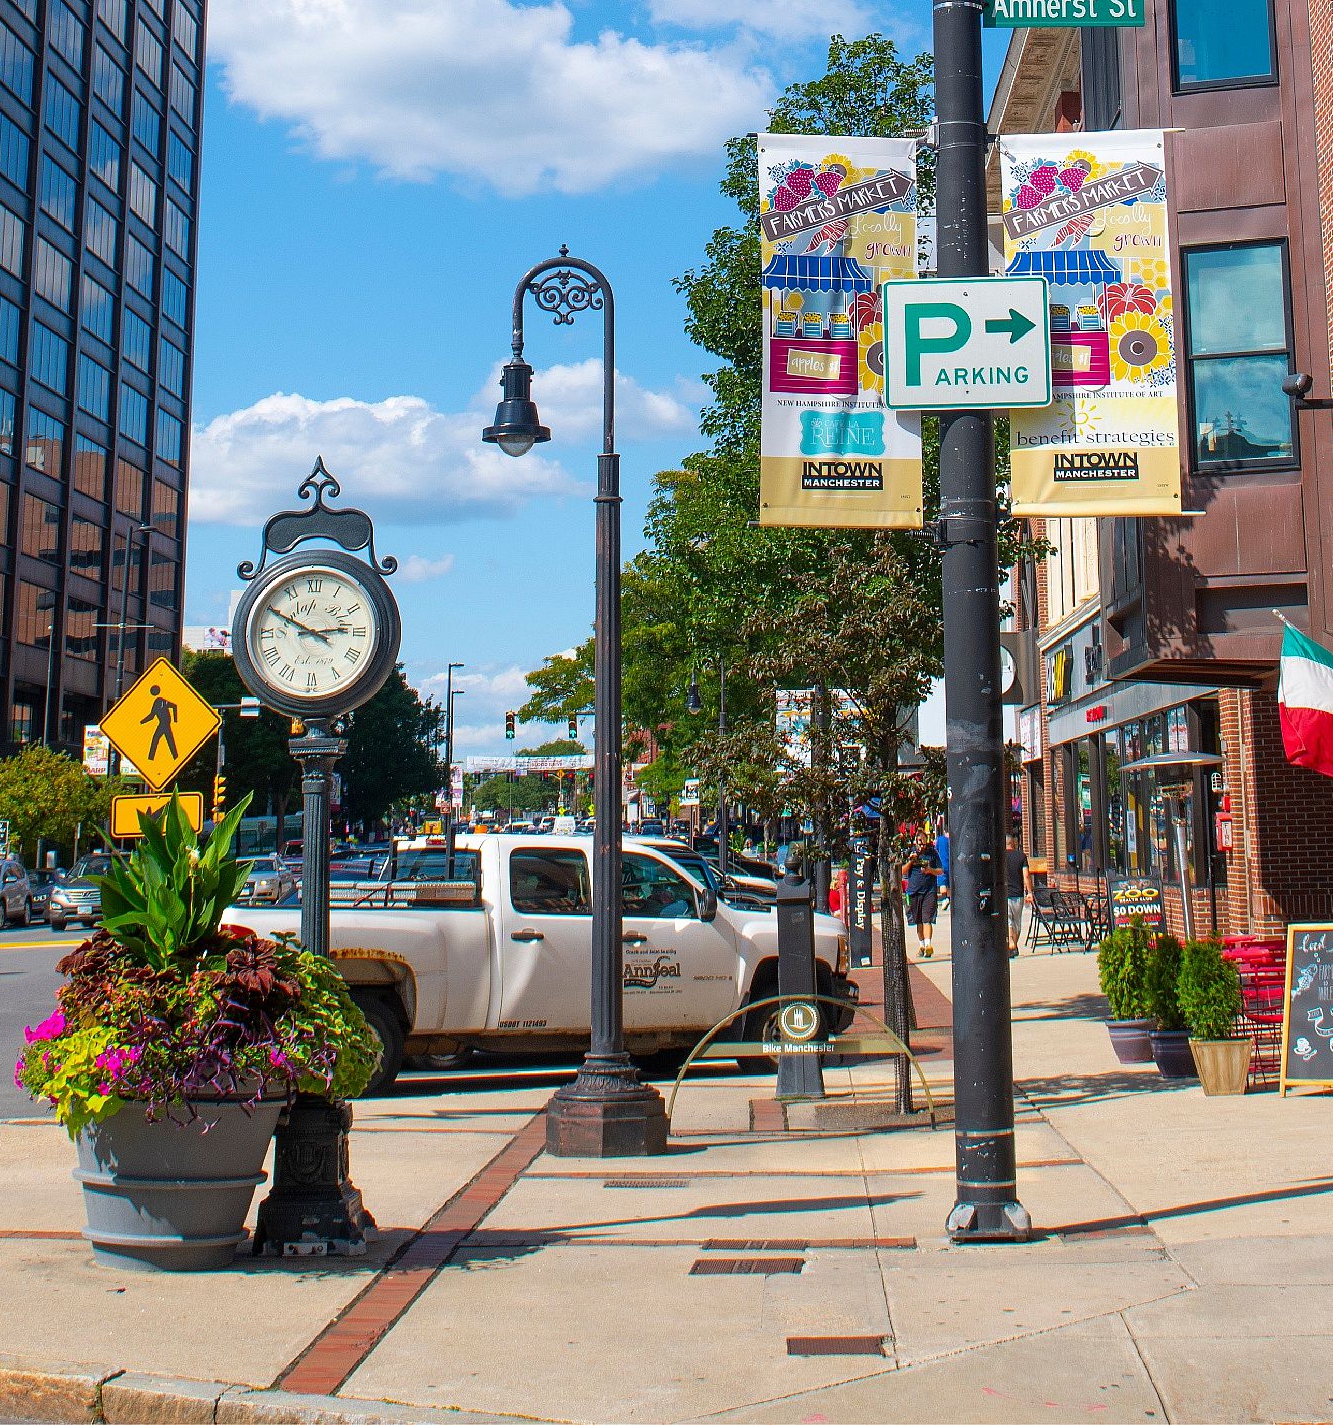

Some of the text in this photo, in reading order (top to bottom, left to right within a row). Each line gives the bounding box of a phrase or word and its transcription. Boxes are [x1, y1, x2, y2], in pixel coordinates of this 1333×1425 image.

[770, 177, 898, 237] FARMERS MARKET
[1012, 169, 1146, 233] FARMERS MARKET
[866, 242, 911, 260] grown
[1113, 234, 1162, 252] grown
[790, 356, 825, 374] apples
[1052, 391, 1092, 400] AMPSHIRE
[1093, 391, 1135, 399] INSTITUTE
[1147, 390, 1164, 398] ART
[777, 399, 794, 407] NEW
[795, 400, 841, 408] HAMPSHIRE
[842, 401, 881, 409] INSTITUTE
[810, 427, 875, 447] REINE
[1016, 429, 1175, 447] benefit strategies
[802, 461, 883, 476] INTOWN
[1053, 452, 1138, 469] INTOWN
[803, 478, 880, 487] MANCHESTER
[1055, 469, 1137, 479] MANCHESTER
[854, 858, 866, 930] Pay & Display
[1112, 888, 1159, 901] ZOO
[1113, 903, 1161, 918] $0 DOWN
[762, 1042, 835, 1053] Bike Manchester
